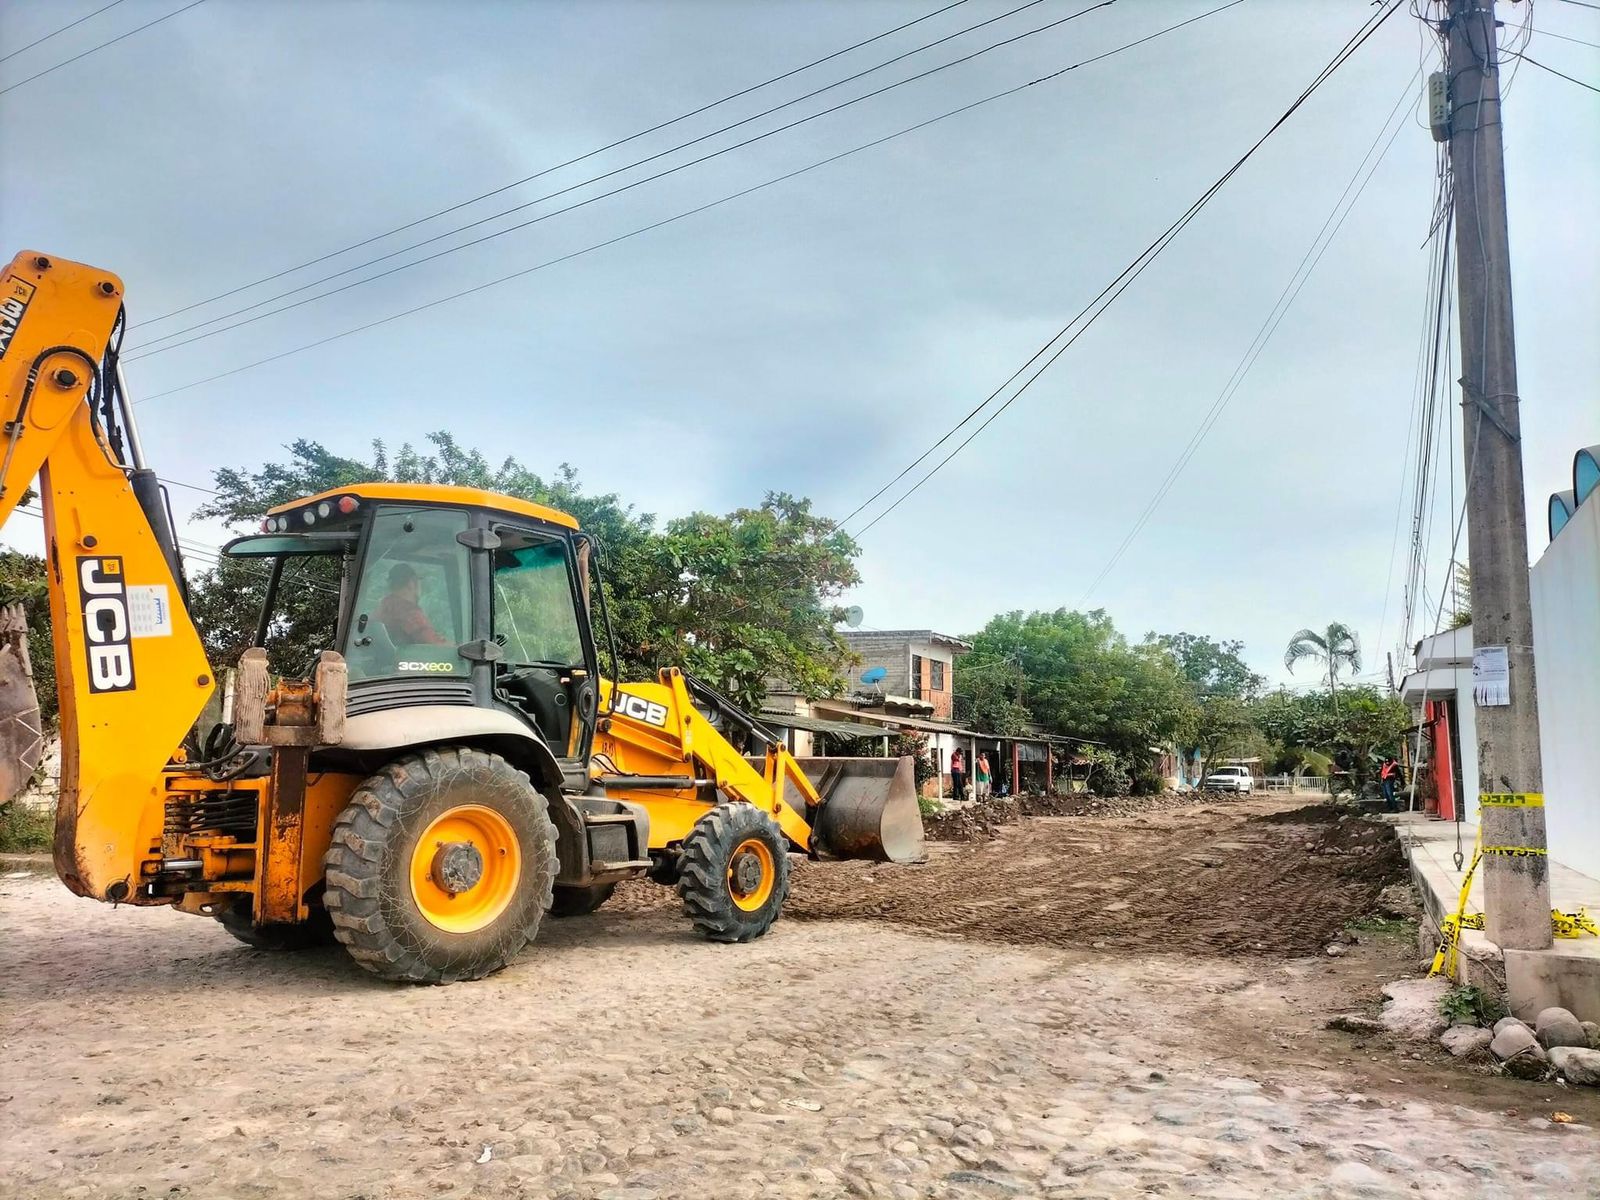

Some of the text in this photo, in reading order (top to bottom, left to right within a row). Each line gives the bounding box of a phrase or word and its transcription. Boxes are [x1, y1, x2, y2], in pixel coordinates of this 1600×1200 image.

[81, 559, 132, 690] JCB
[398, 661, 453, 672] 3CXeco
[609, 692, 667, 726] JCB
